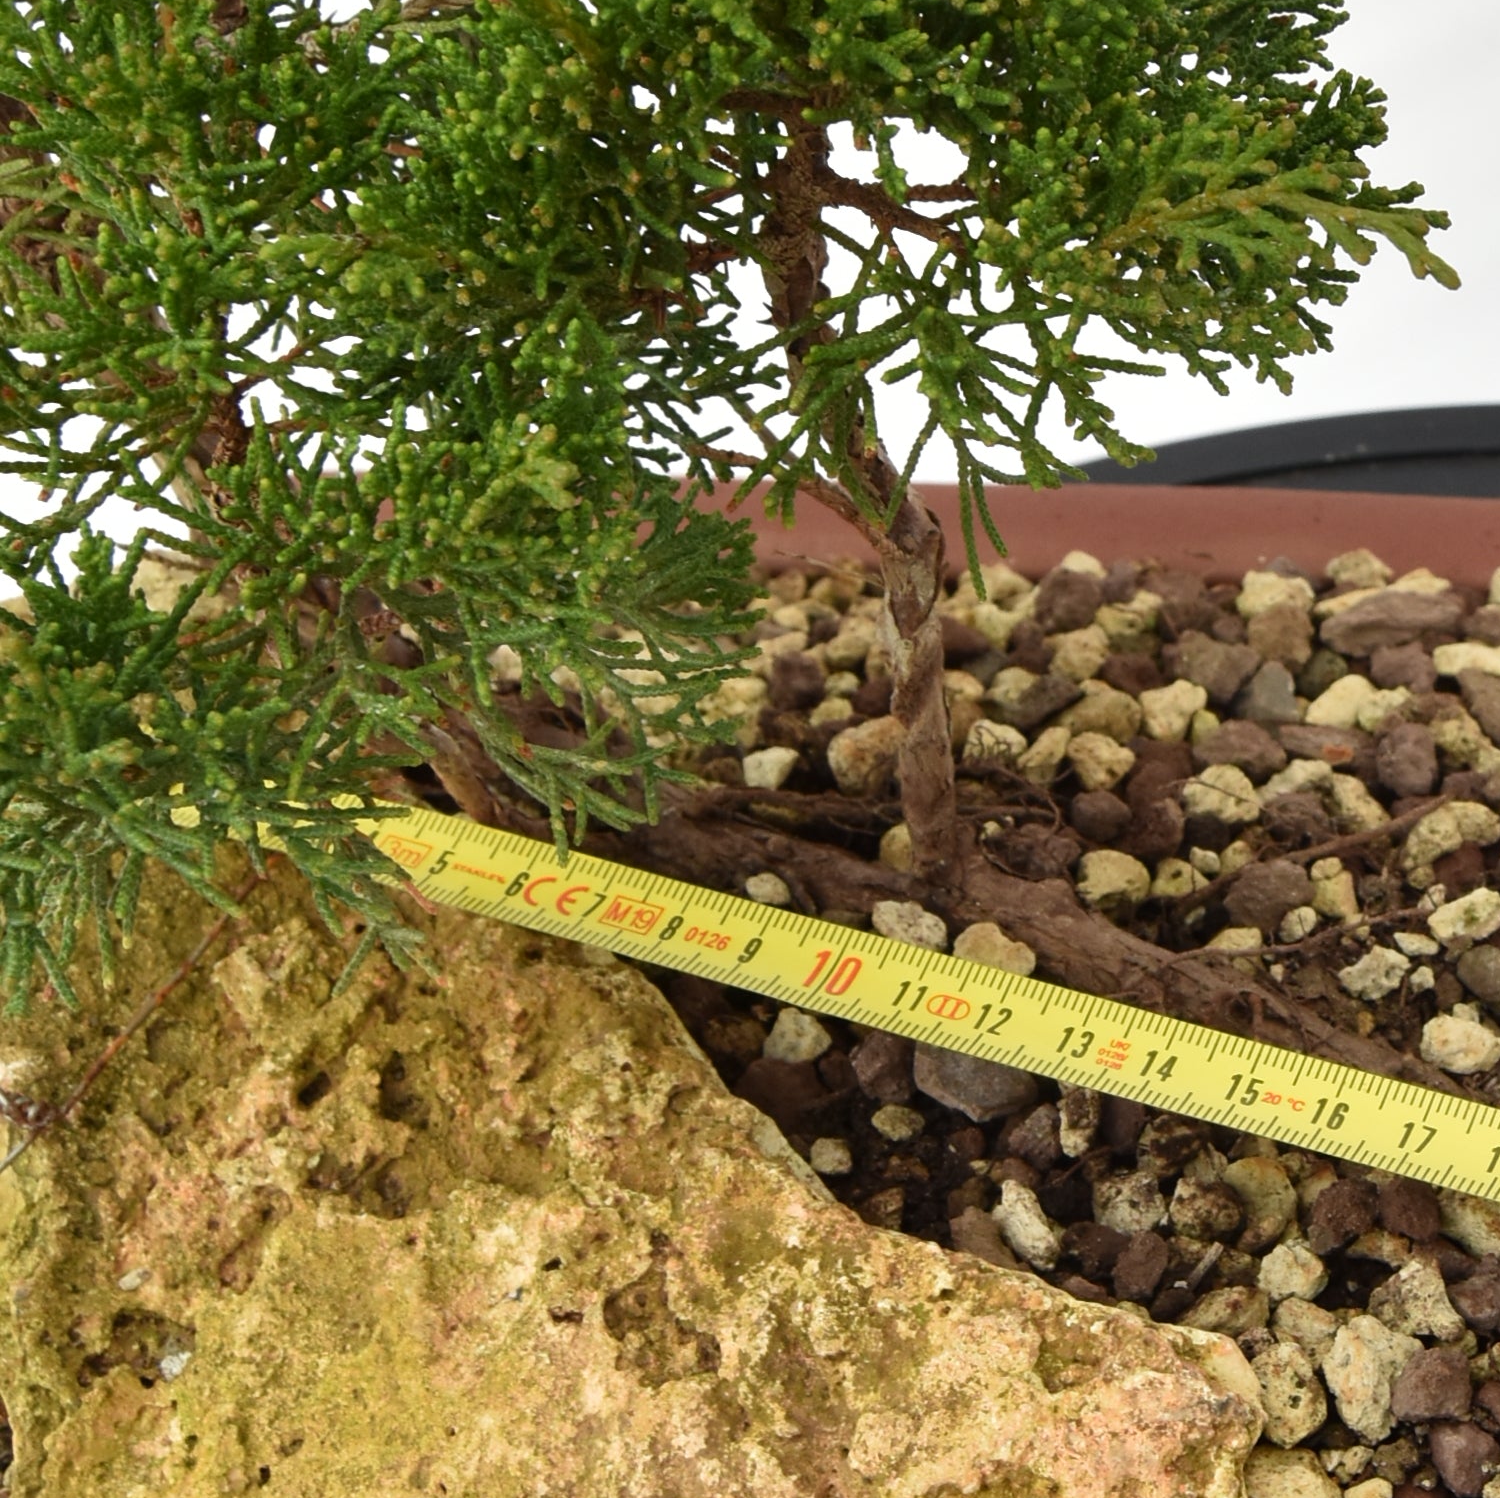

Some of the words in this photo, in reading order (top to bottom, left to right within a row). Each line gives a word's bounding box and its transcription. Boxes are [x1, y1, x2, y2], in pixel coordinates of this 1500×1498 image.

[429, 851, 455, 875] 5
[505, 871, 530, 897] 6
[523, 876, 590, 916] CE
[582, 893, 606, 918] 7
[659, 915, 684, 941] 8
[684, 926, 732, 952] 0126
[738, 937, 763, 964] 9
[803, 950, 863, 996] 10
[891, 981, 929, 1012] 11
[973, 1003, 1013, 1036] 12
[1056, 1026, 1095, 1058] 13
[1140, 1050, 1178, 1082] 14
[1224, 1073, 1264, 1106] 15
[1261, 1091, 1283, 1105] 20
[1309, 1098, 1350, 1130] 16
[1397, 1122, 1437, 1154] 17
